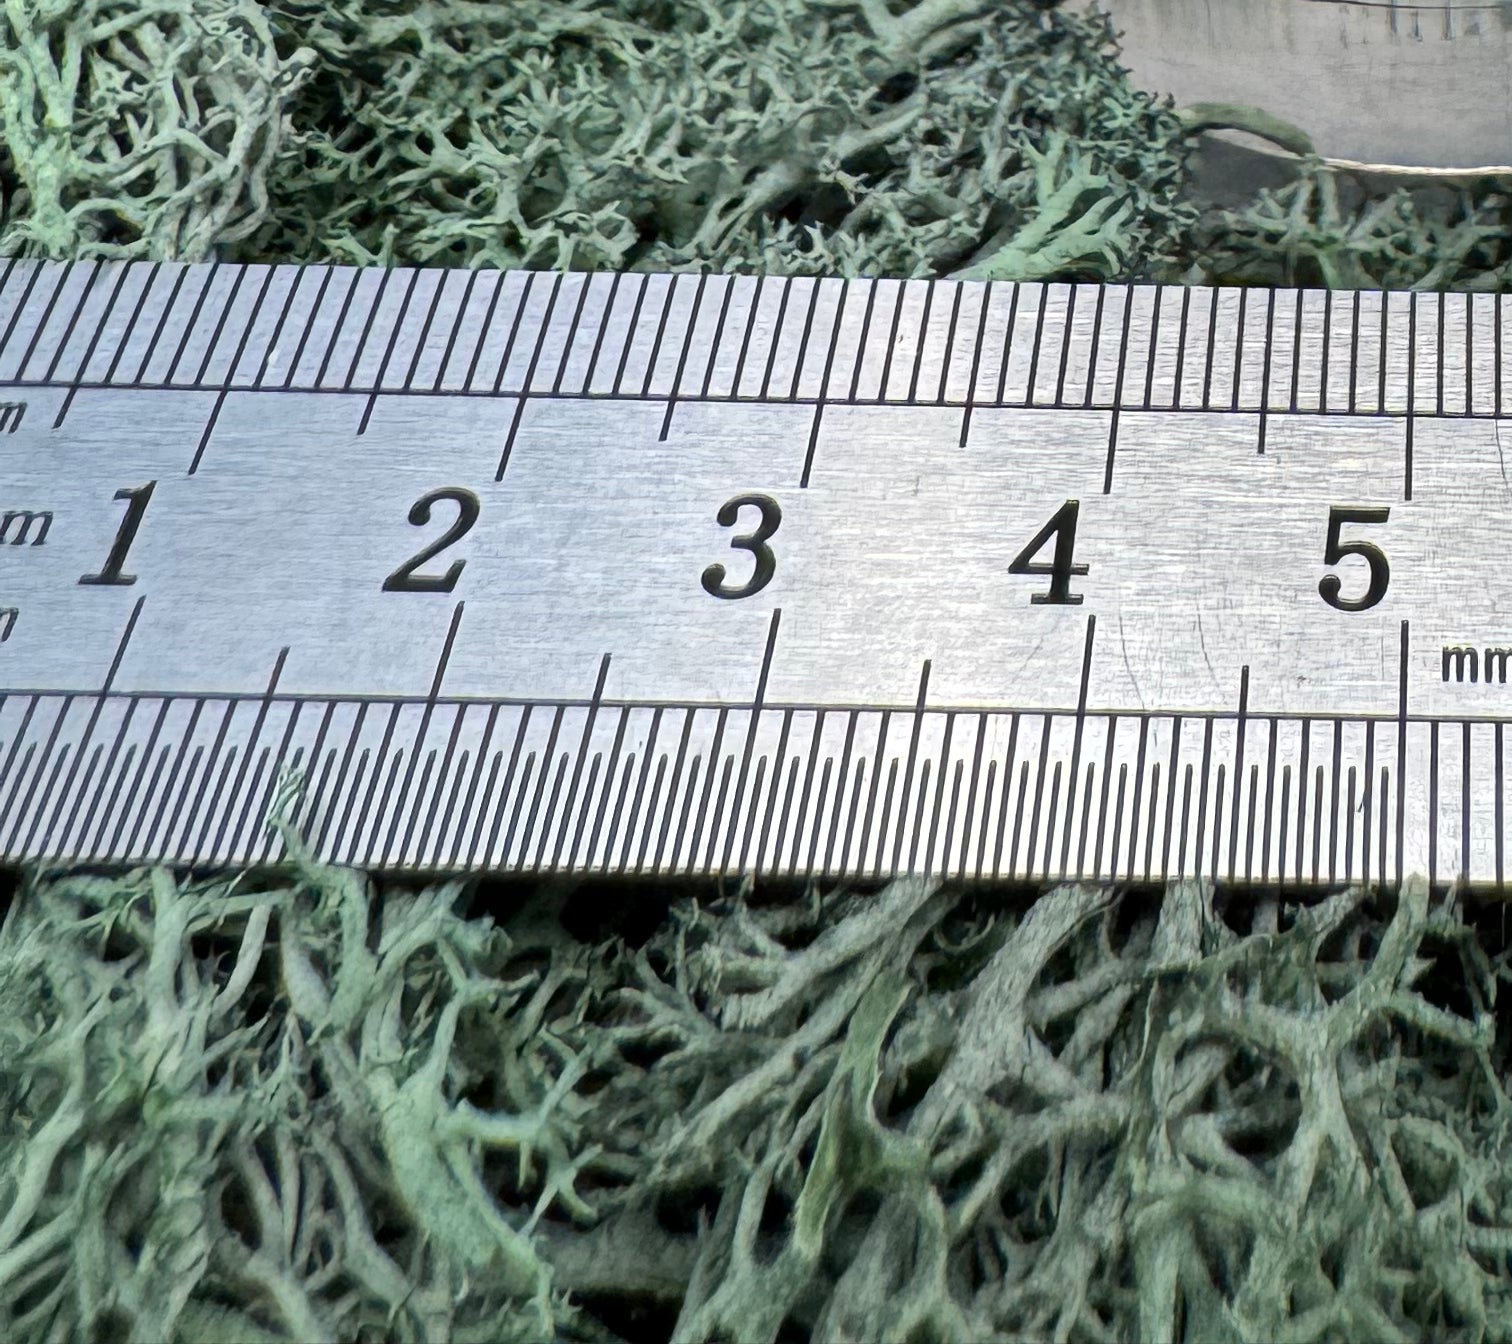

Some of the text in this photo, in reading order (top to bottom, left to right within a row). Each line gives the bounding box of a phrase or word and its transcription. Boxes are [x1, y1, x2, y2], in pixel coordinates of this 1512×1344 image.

[0, 510, 53, 547] m
[78, 479, 158, 586] 1
[381, 487, 480, 594] 2
[701, 494, 782, 600] 3
[1007, 499, 1090, 606] 4
[1317, 505, 1391, 612] 5
